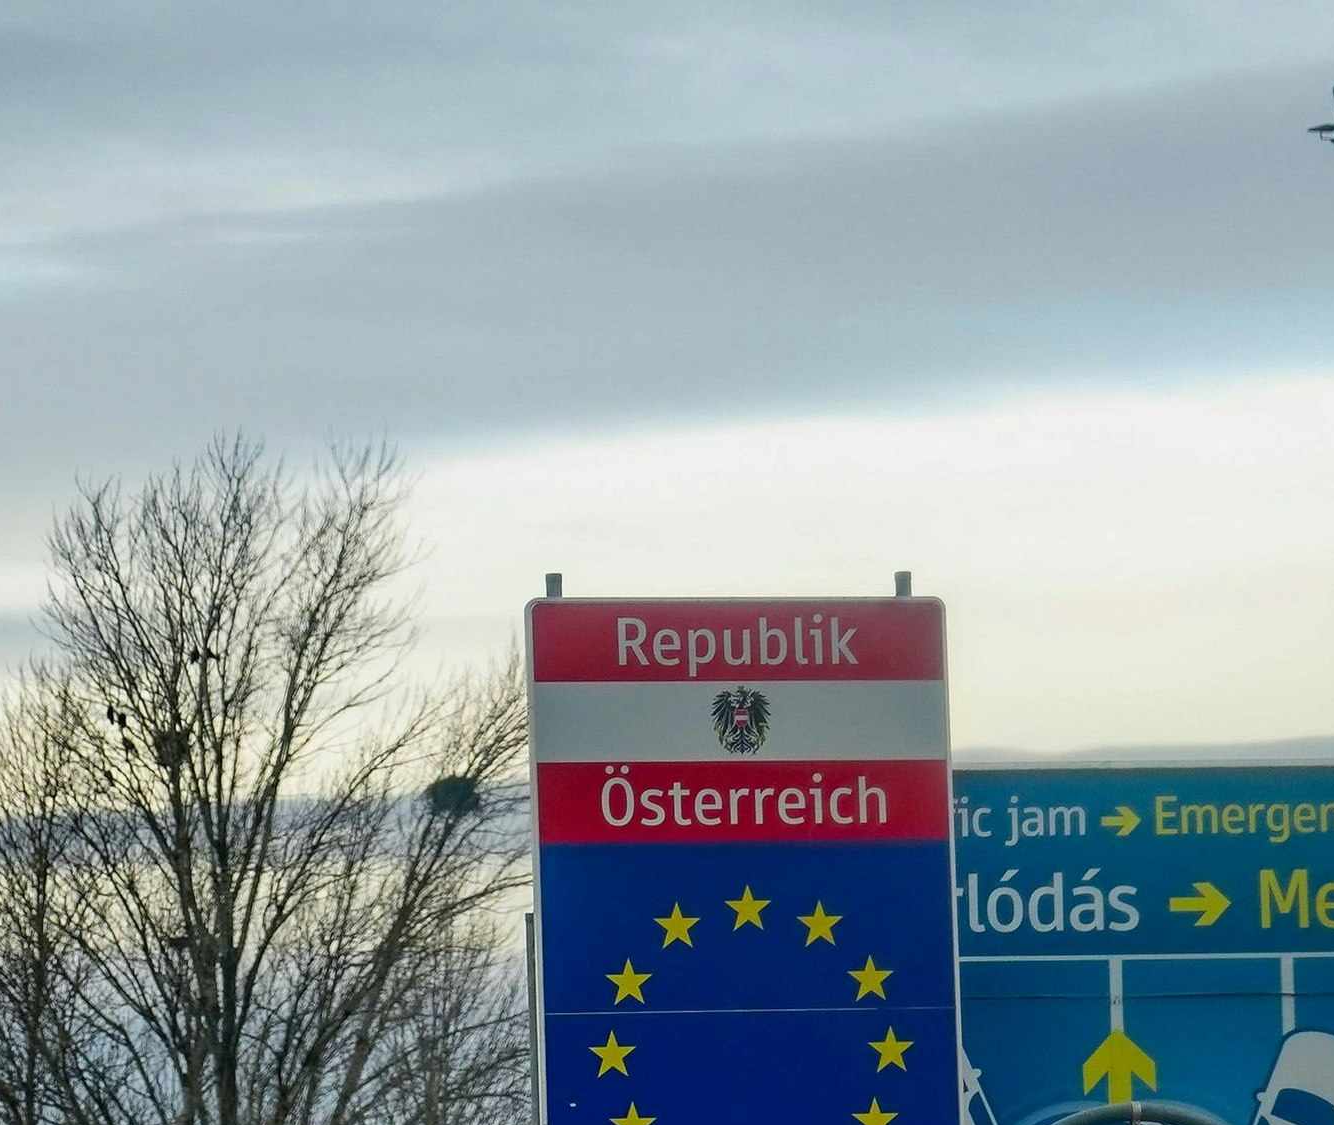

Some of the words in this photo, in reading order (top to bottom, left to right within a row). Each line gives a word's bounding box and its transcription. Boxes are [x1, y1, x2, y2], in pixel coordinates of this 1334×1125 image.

[617, 613, 859, 678] Republik
[601, 765, 888, 827] Österreich
[1004, 795, 1086, 846] jam
